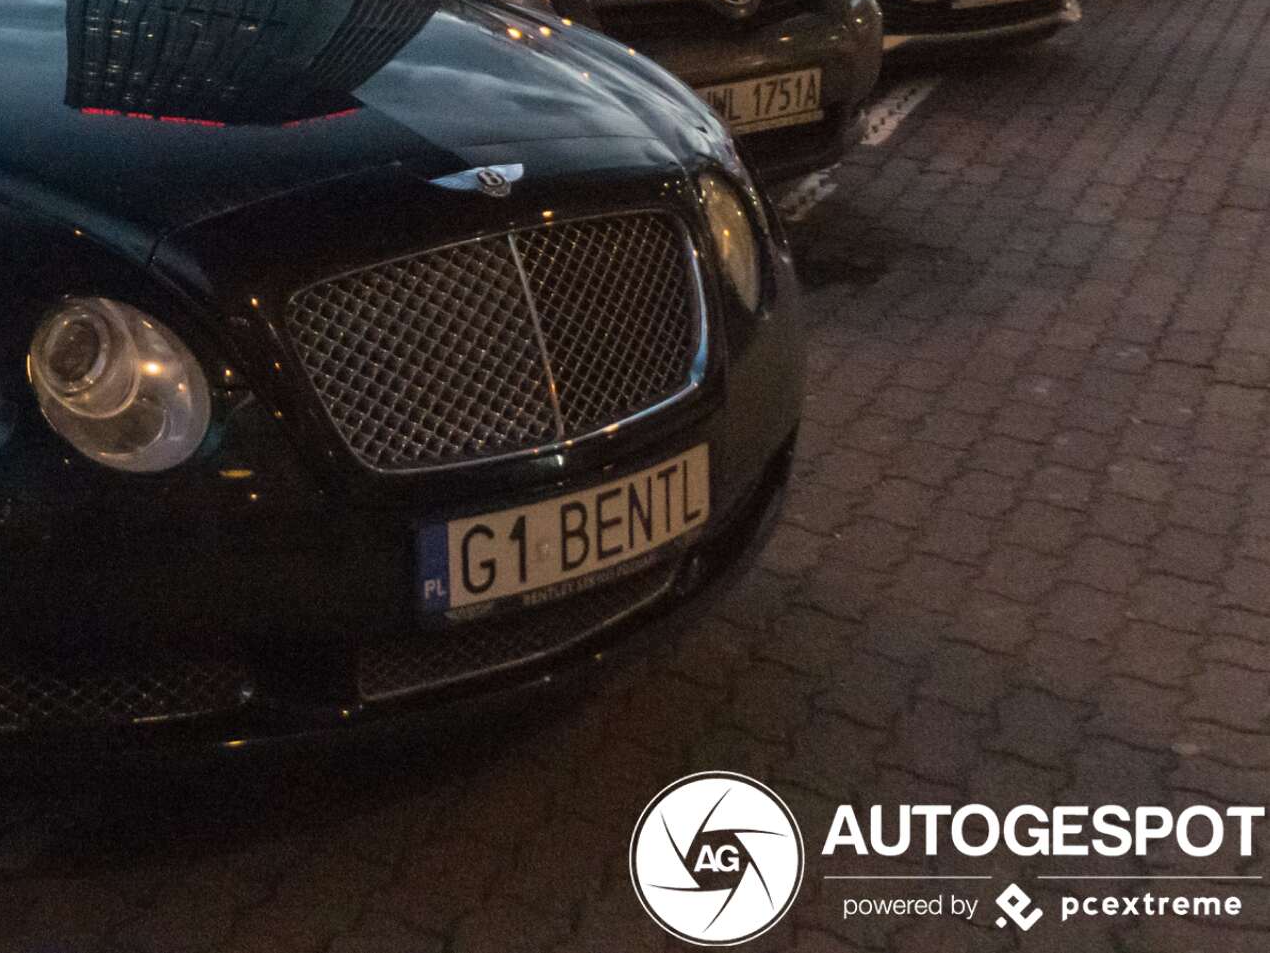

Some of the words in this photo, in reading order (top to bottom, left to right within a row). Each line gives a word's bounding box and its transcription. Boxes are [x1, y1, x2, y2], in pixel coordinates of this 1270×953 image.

[752, 73, 818, 117] 1751A
[461, 514, 527, 594] G1
[559, 459, 702, 572] BENTL
